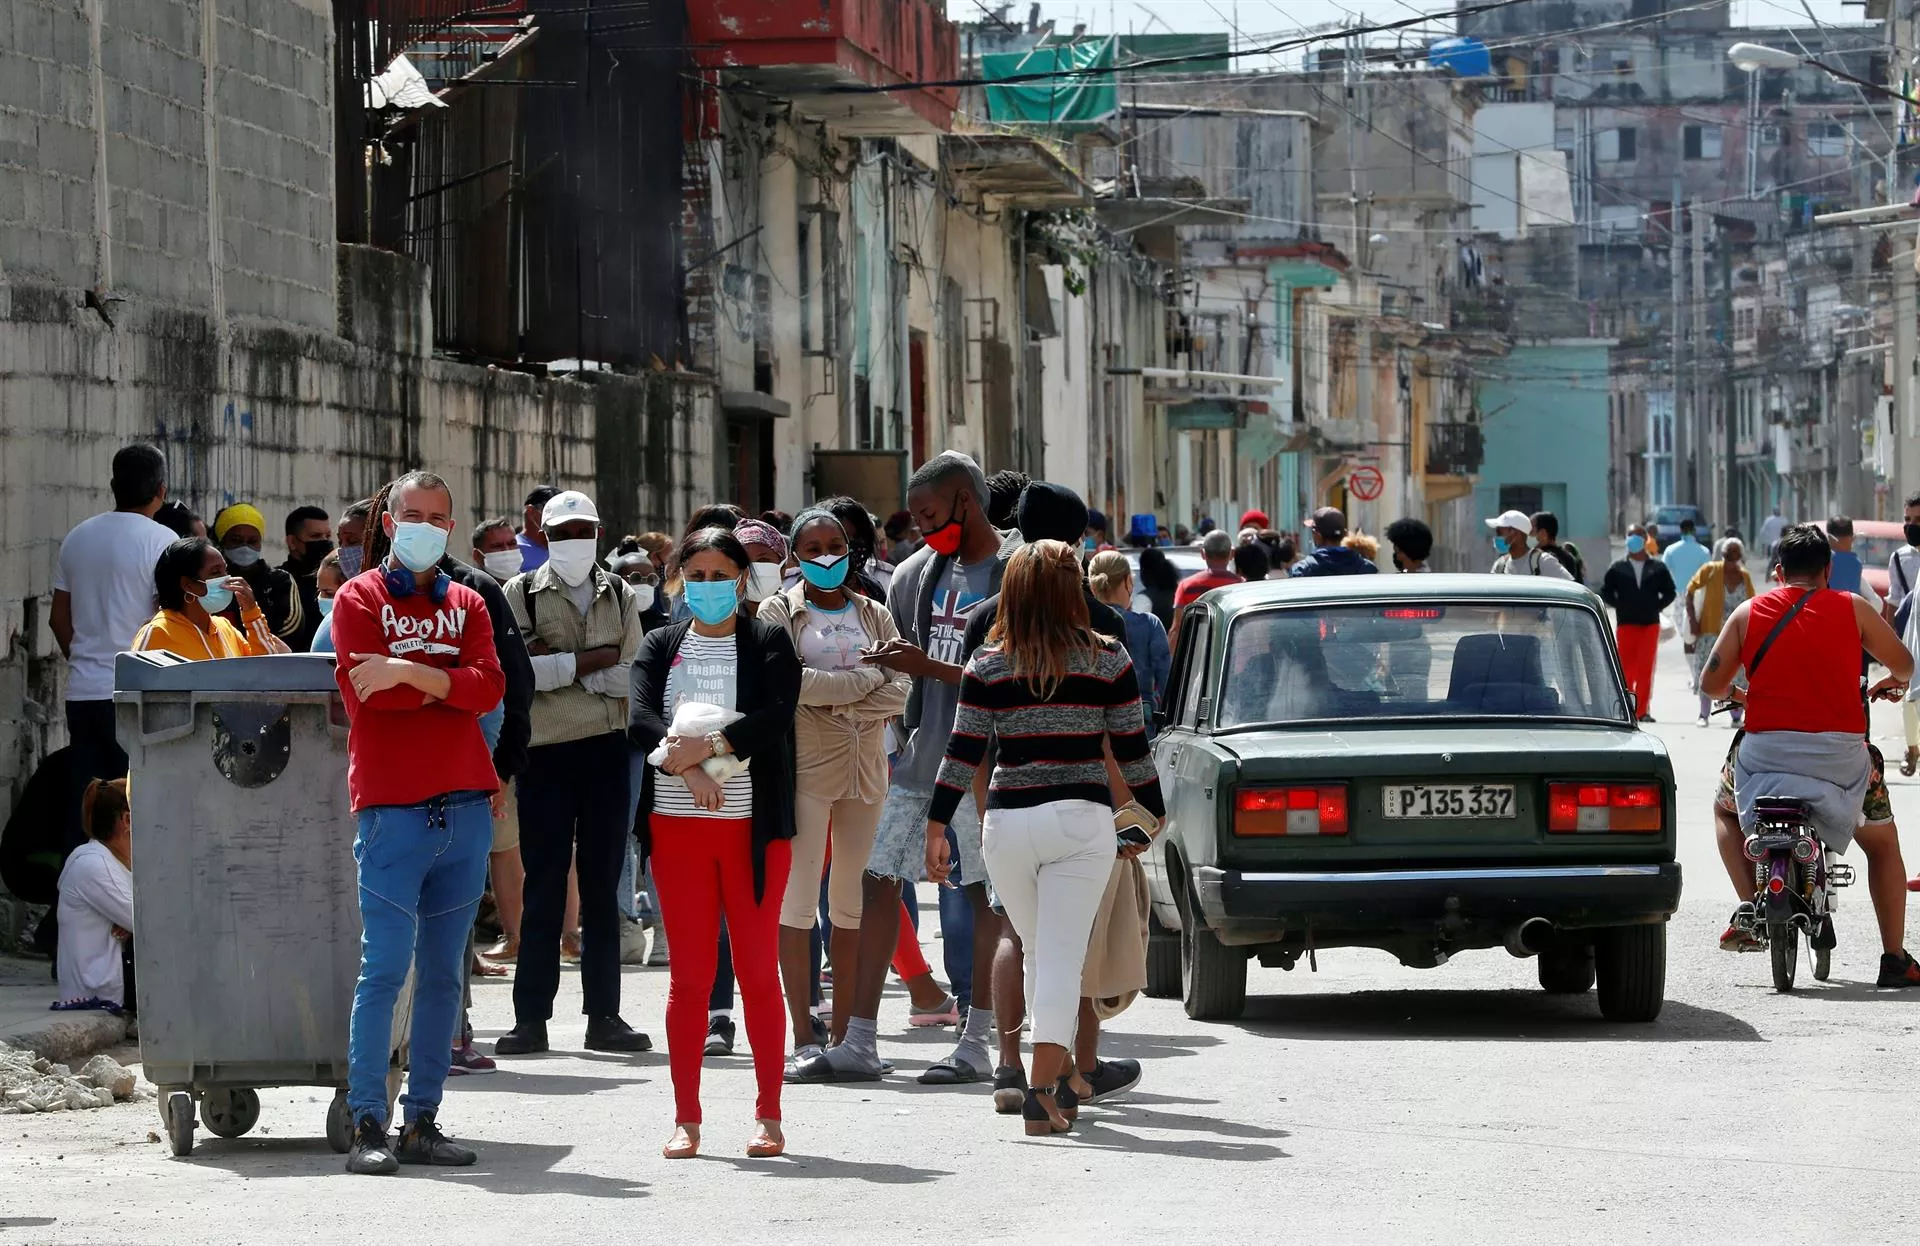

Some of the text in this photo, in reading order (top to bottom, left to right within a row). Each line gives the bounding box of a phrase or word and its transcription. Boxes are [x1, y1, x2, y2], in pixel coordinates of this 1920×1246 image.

[936, 623, 955, 638] THE
[394, 640, 423, 651] ATHLETI
[687, 664, 736, 676] EMBRACE
[696, 678, 724, 690] YOUR
